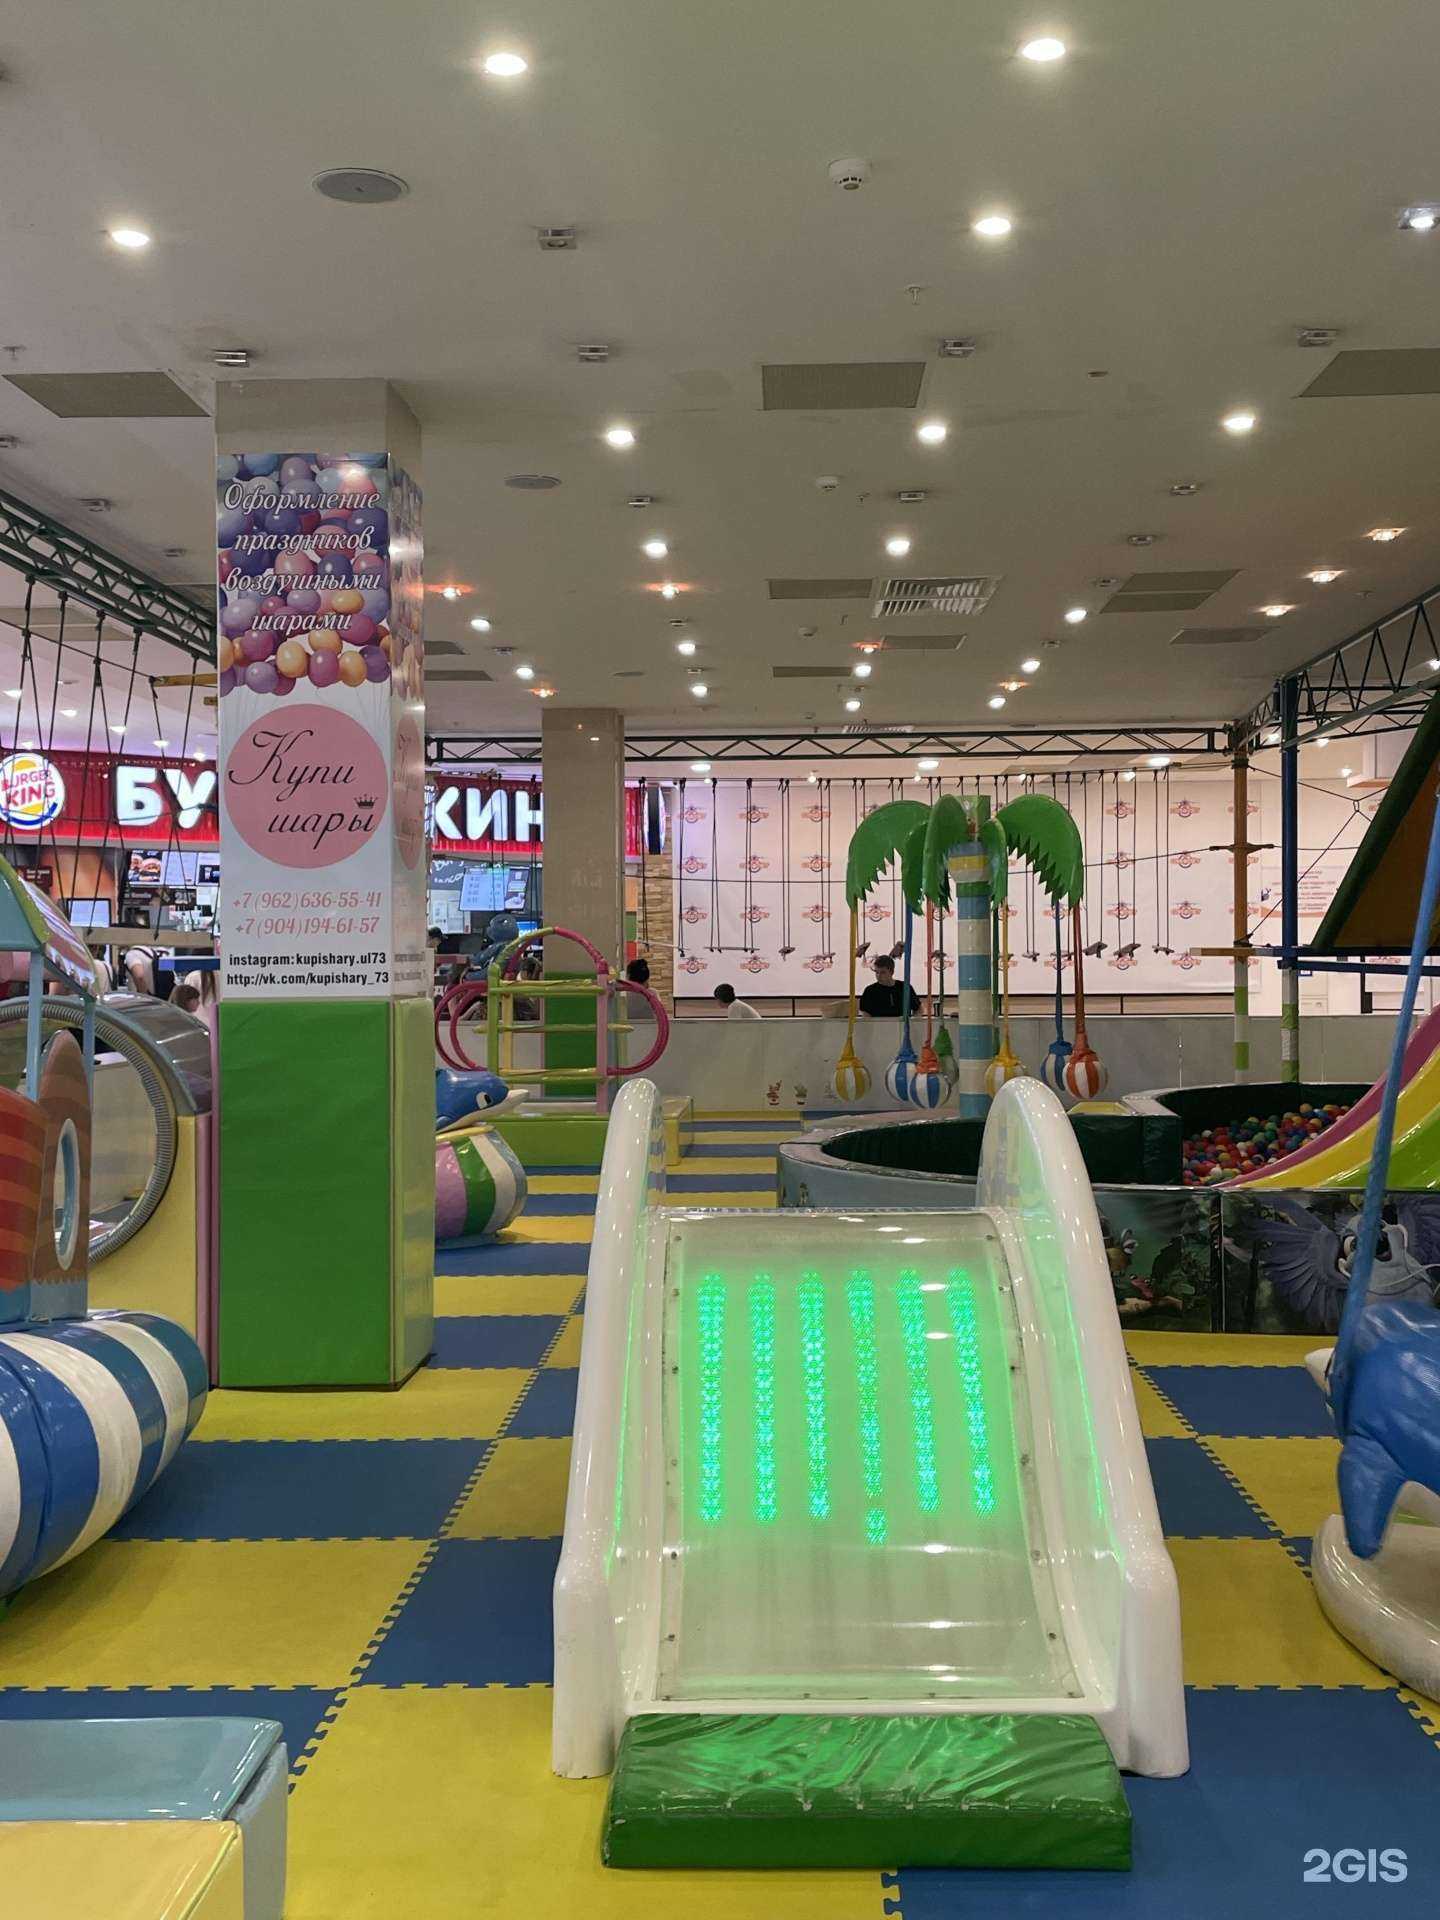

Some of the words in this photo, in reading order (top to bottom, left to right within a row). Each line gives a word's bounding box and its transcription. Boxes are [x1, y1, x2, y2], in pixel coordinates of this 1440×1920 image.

[225, 482, 380, 515] Оформление
[235, 525, 375, 555] праздников
[226, 567, 380, 595] воздушными
[251, 612, 352, 636] шарами
[229, 729, 356, 802] Купи
[8, 781, 56, 807] KING
[268, 812, 378, 850] шары
[227, 972, 389, 987] http://vk.com/kupishary_73
